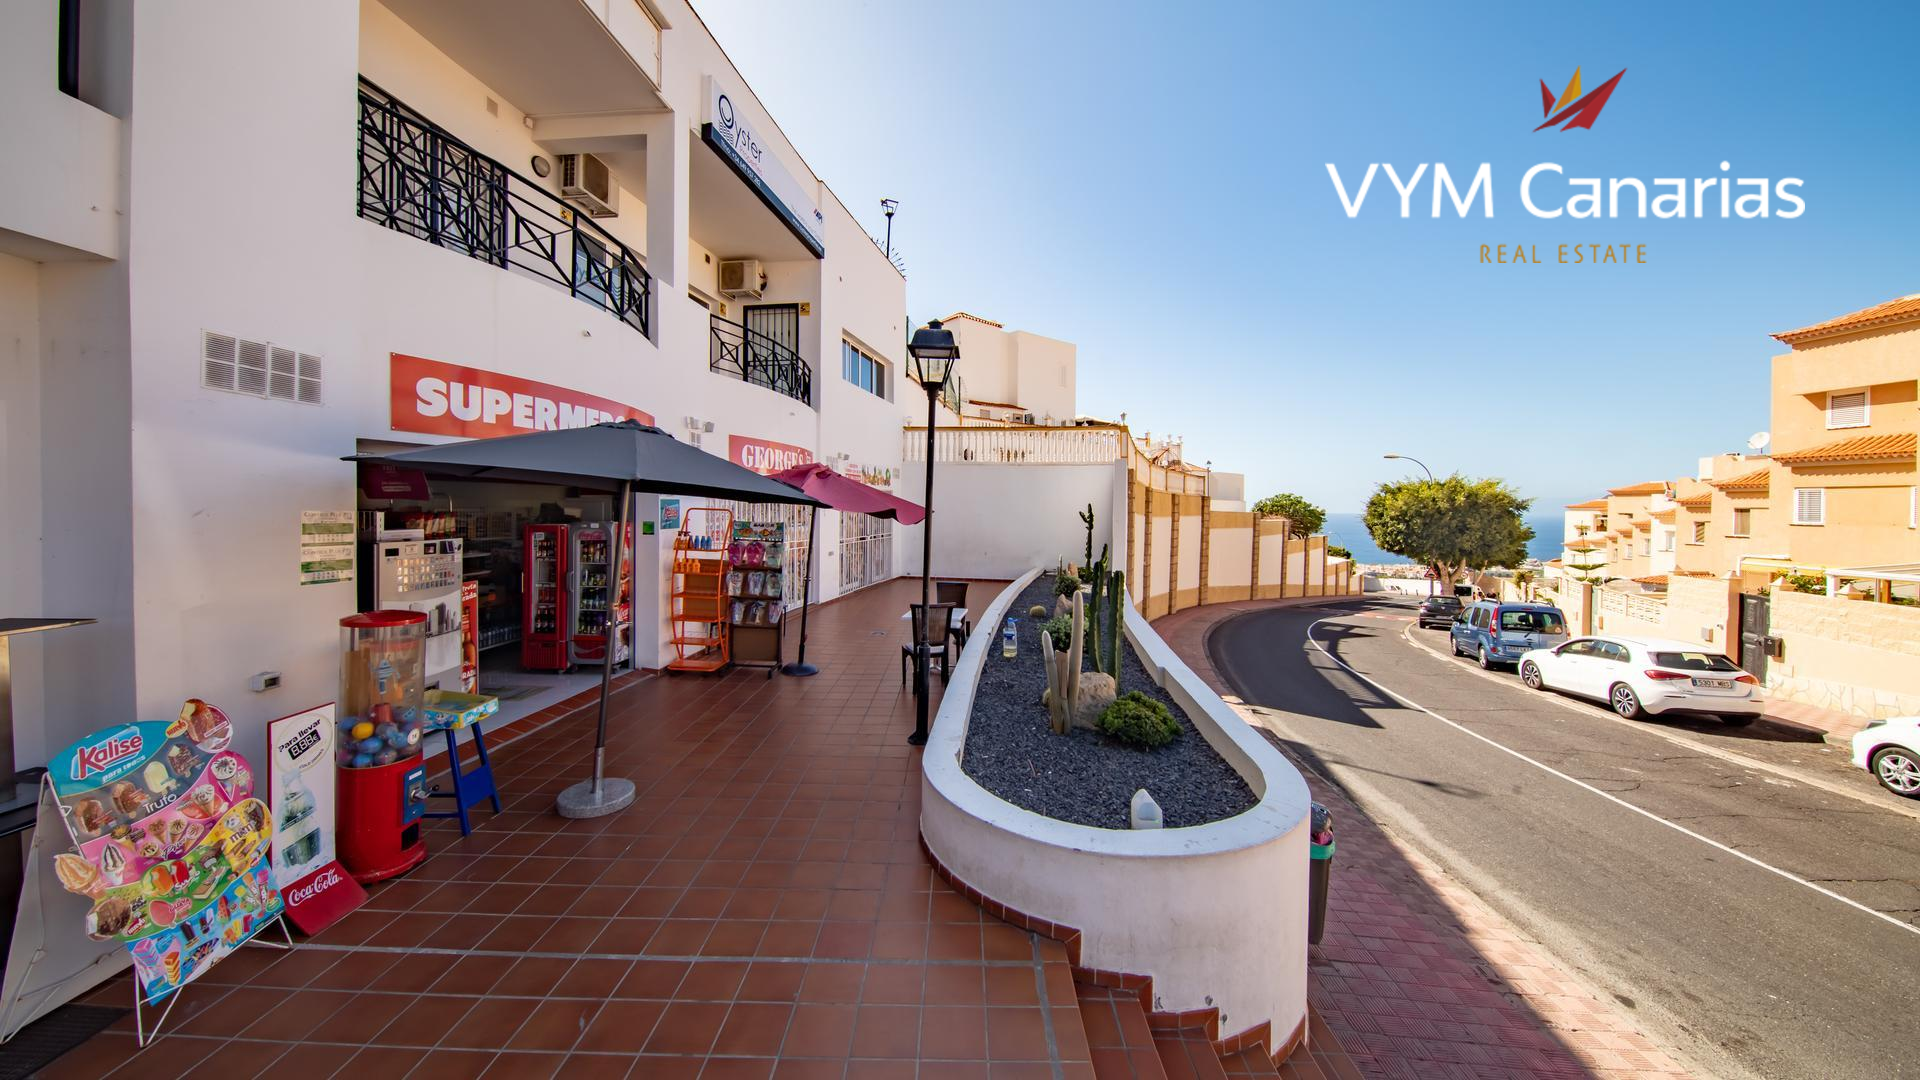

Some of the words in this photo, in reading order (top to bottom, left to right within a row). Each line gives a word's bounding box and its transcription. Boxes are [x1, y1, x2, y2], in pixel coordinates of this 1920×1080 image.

[719, 94, 762, 163] Oyster
[278, 736, 299, 753] Para
[298, 719, 321, 738] llevar
[78, 735, 143, 780] Kalise
[143, 793, 177, 813] Trufo
[288, 867, 343, 907] Coca-Cola
